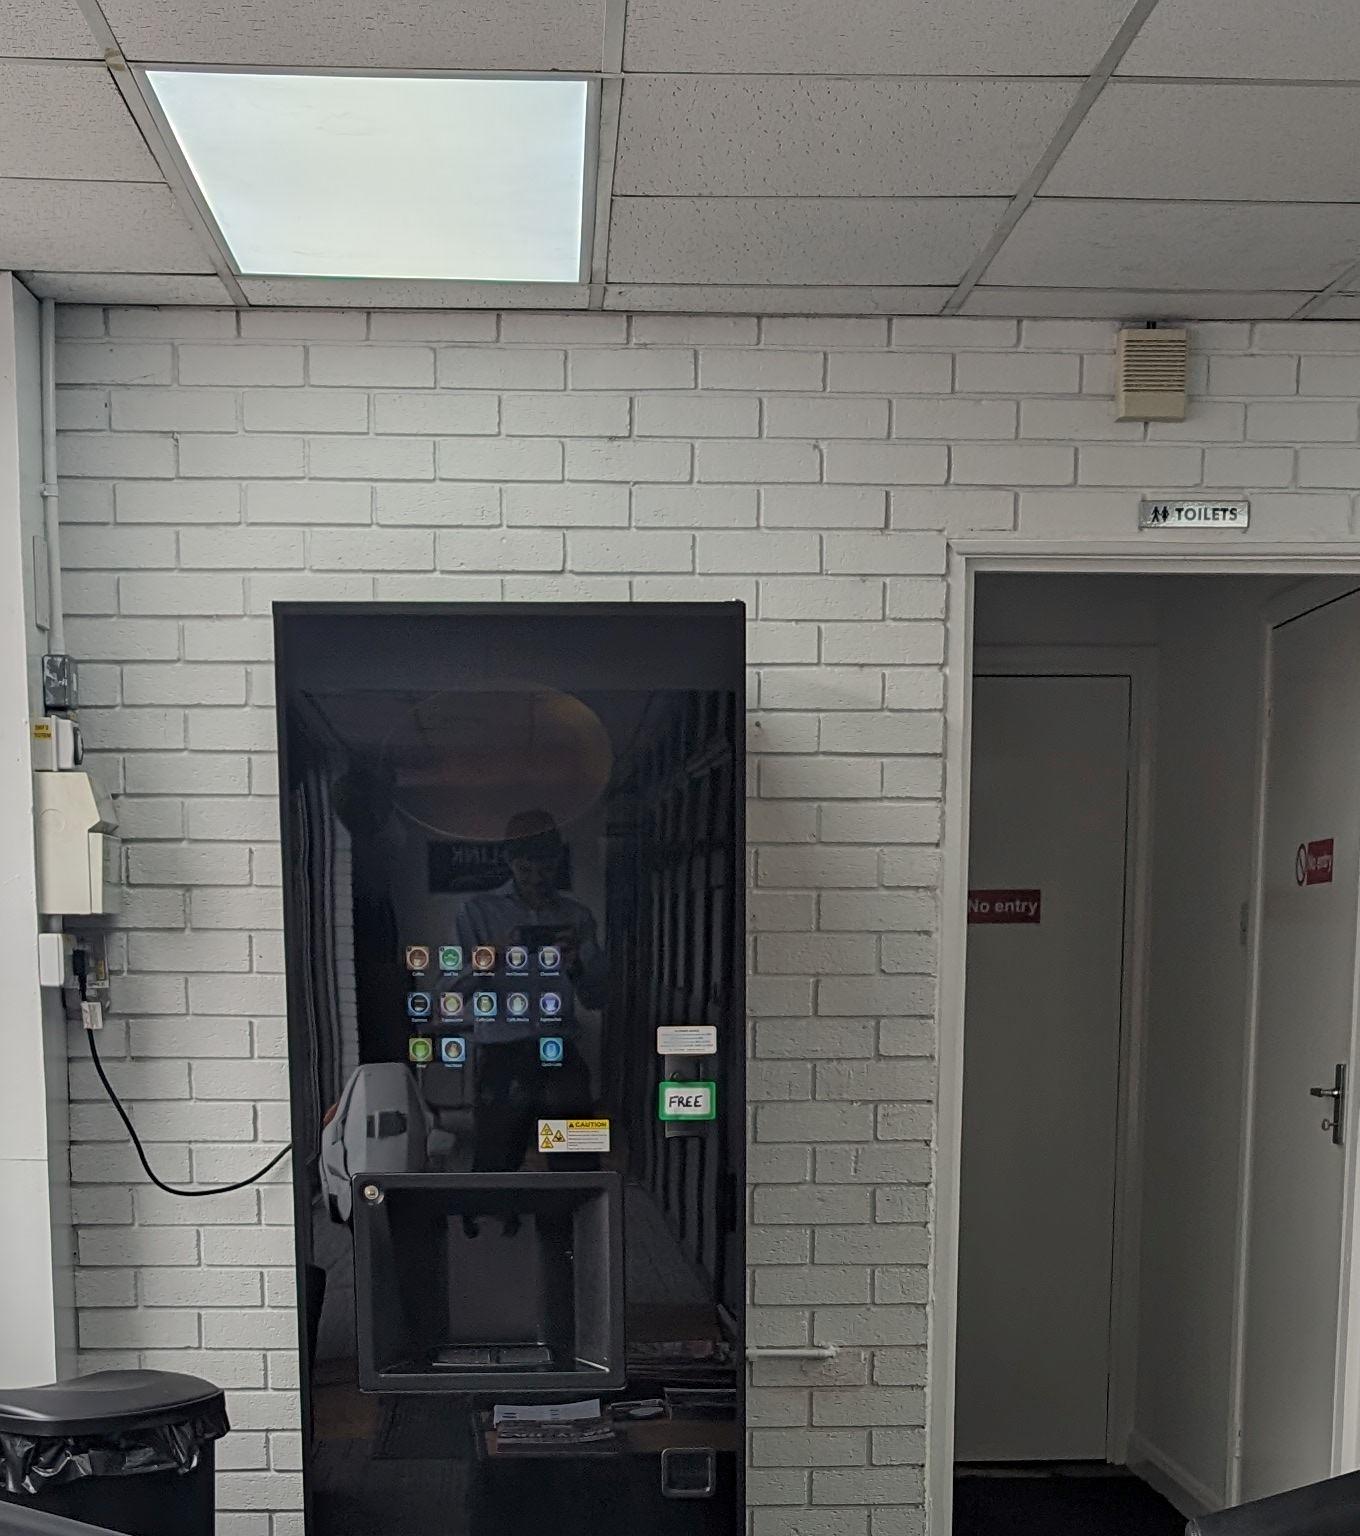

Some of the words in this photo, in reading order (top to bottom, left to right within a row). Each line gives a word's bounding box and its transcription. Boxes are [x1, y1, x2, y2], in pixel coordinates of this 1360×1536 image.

[1175, 507, 1239, 521] TOILETS
[969, 899, 990, 913] No
[994, 899, 1038, 916] entry
[668, 1094, 703, 1109] FREE
